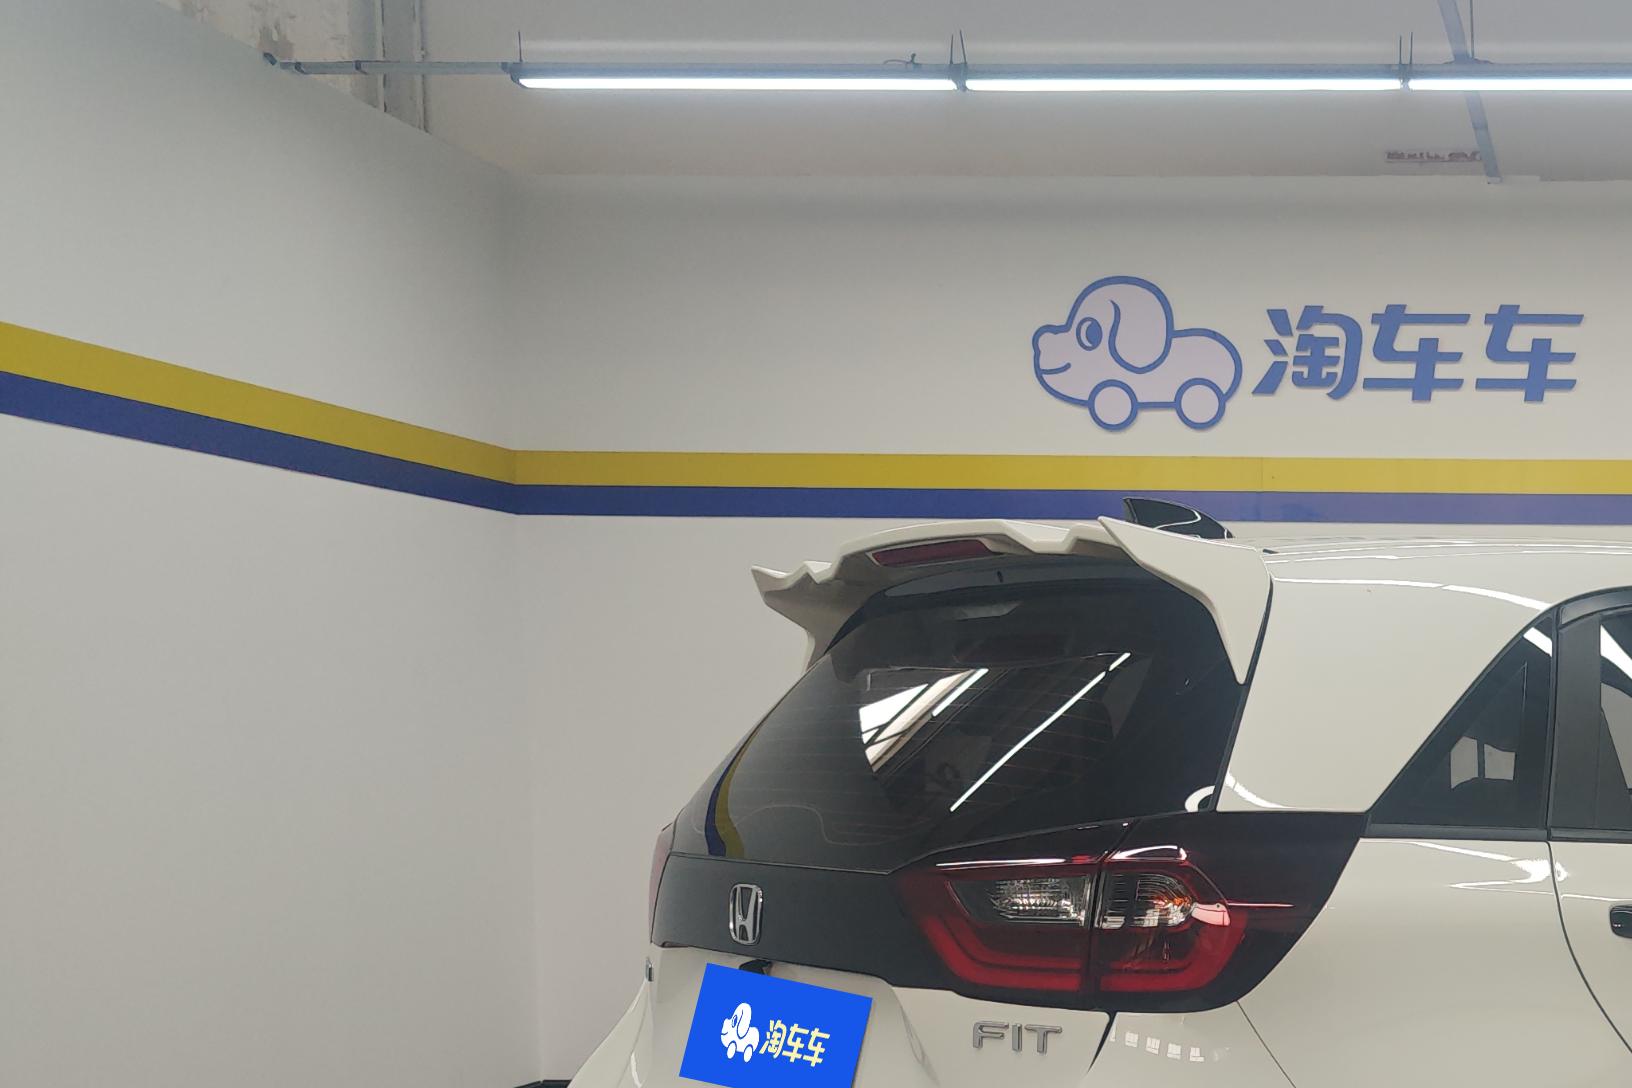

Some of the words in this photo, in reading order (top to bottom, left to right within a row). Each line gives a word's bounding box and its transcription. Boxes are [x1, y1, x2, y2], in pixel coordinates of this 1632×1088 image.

[1251, 304, 1584, 402] 淘车车
[972, 1020, 1063, 1055] FIT
